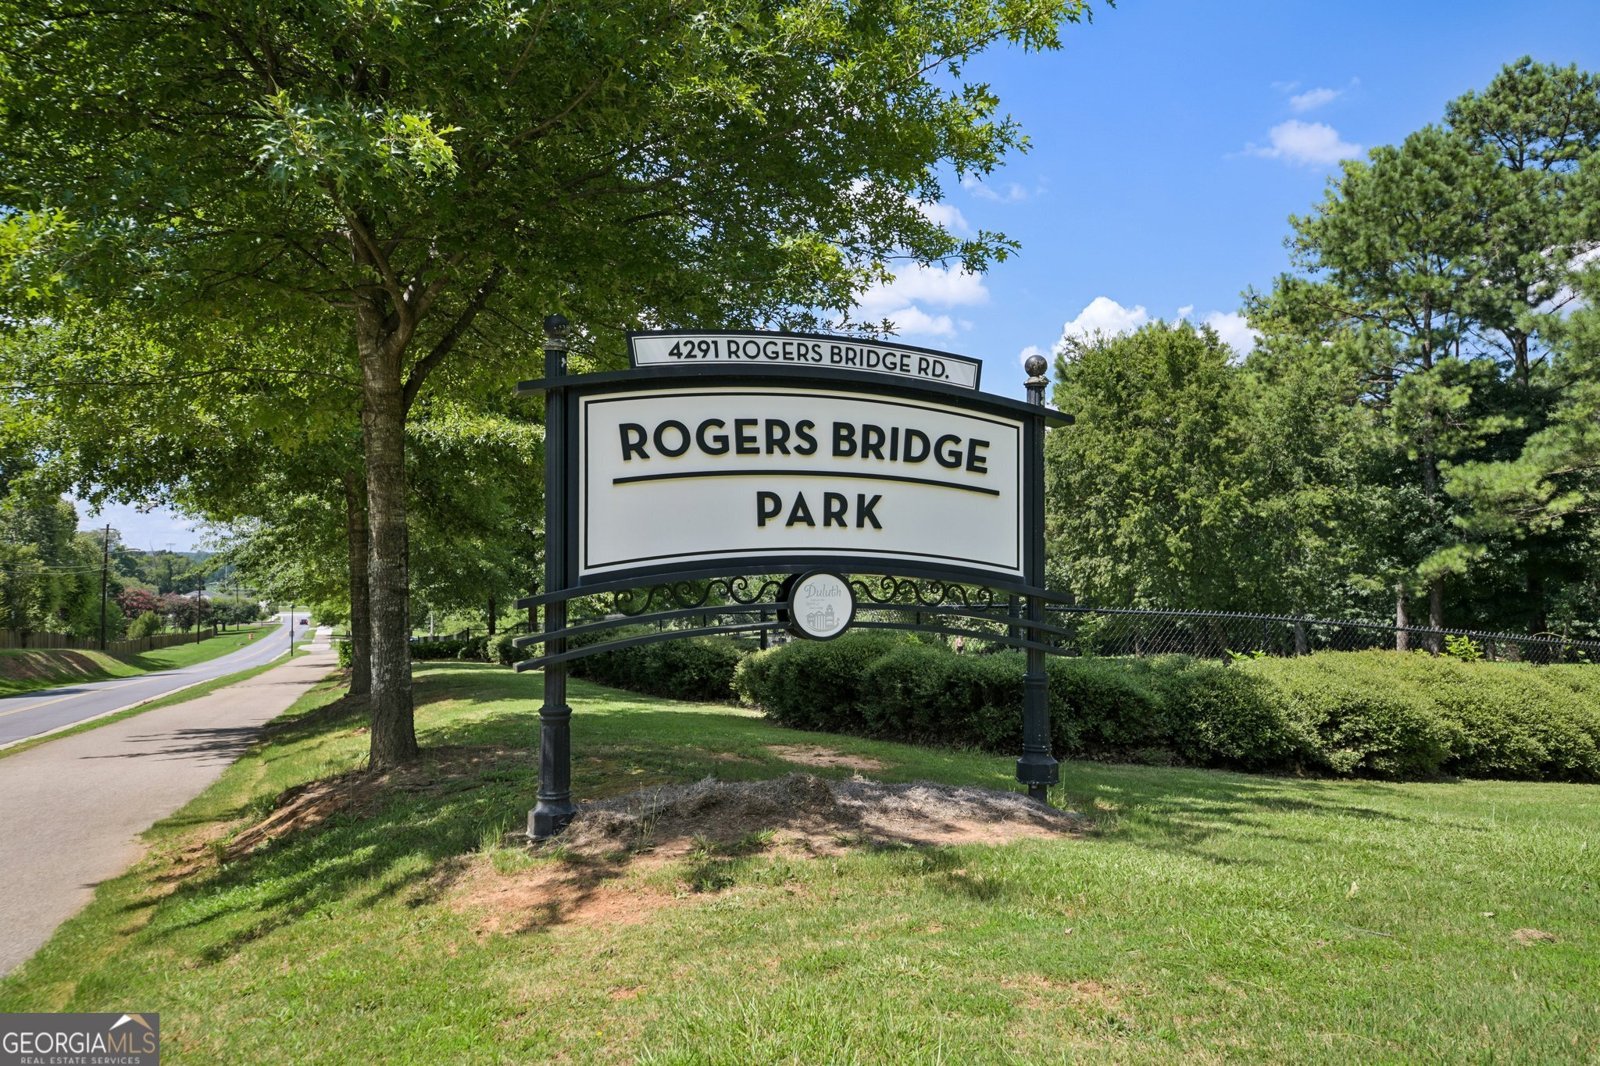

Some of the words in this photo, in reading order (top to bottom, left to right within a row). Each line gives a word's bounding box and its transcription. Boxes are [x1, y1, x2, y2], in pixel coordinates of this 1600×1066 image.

[668, 339, 719, 359] 4291
[726, 340, 823, 362] ROGERS
[830, 347, 911, 374] BRIDGE
[915, 356, 950, 380] RD.
[619, 418, 818, 460] ROGERS
[832, 421, 990, 474] BRIDGE
[755, 490, 883, 530] PARK
[804, 581, 842, 598] Duluth
